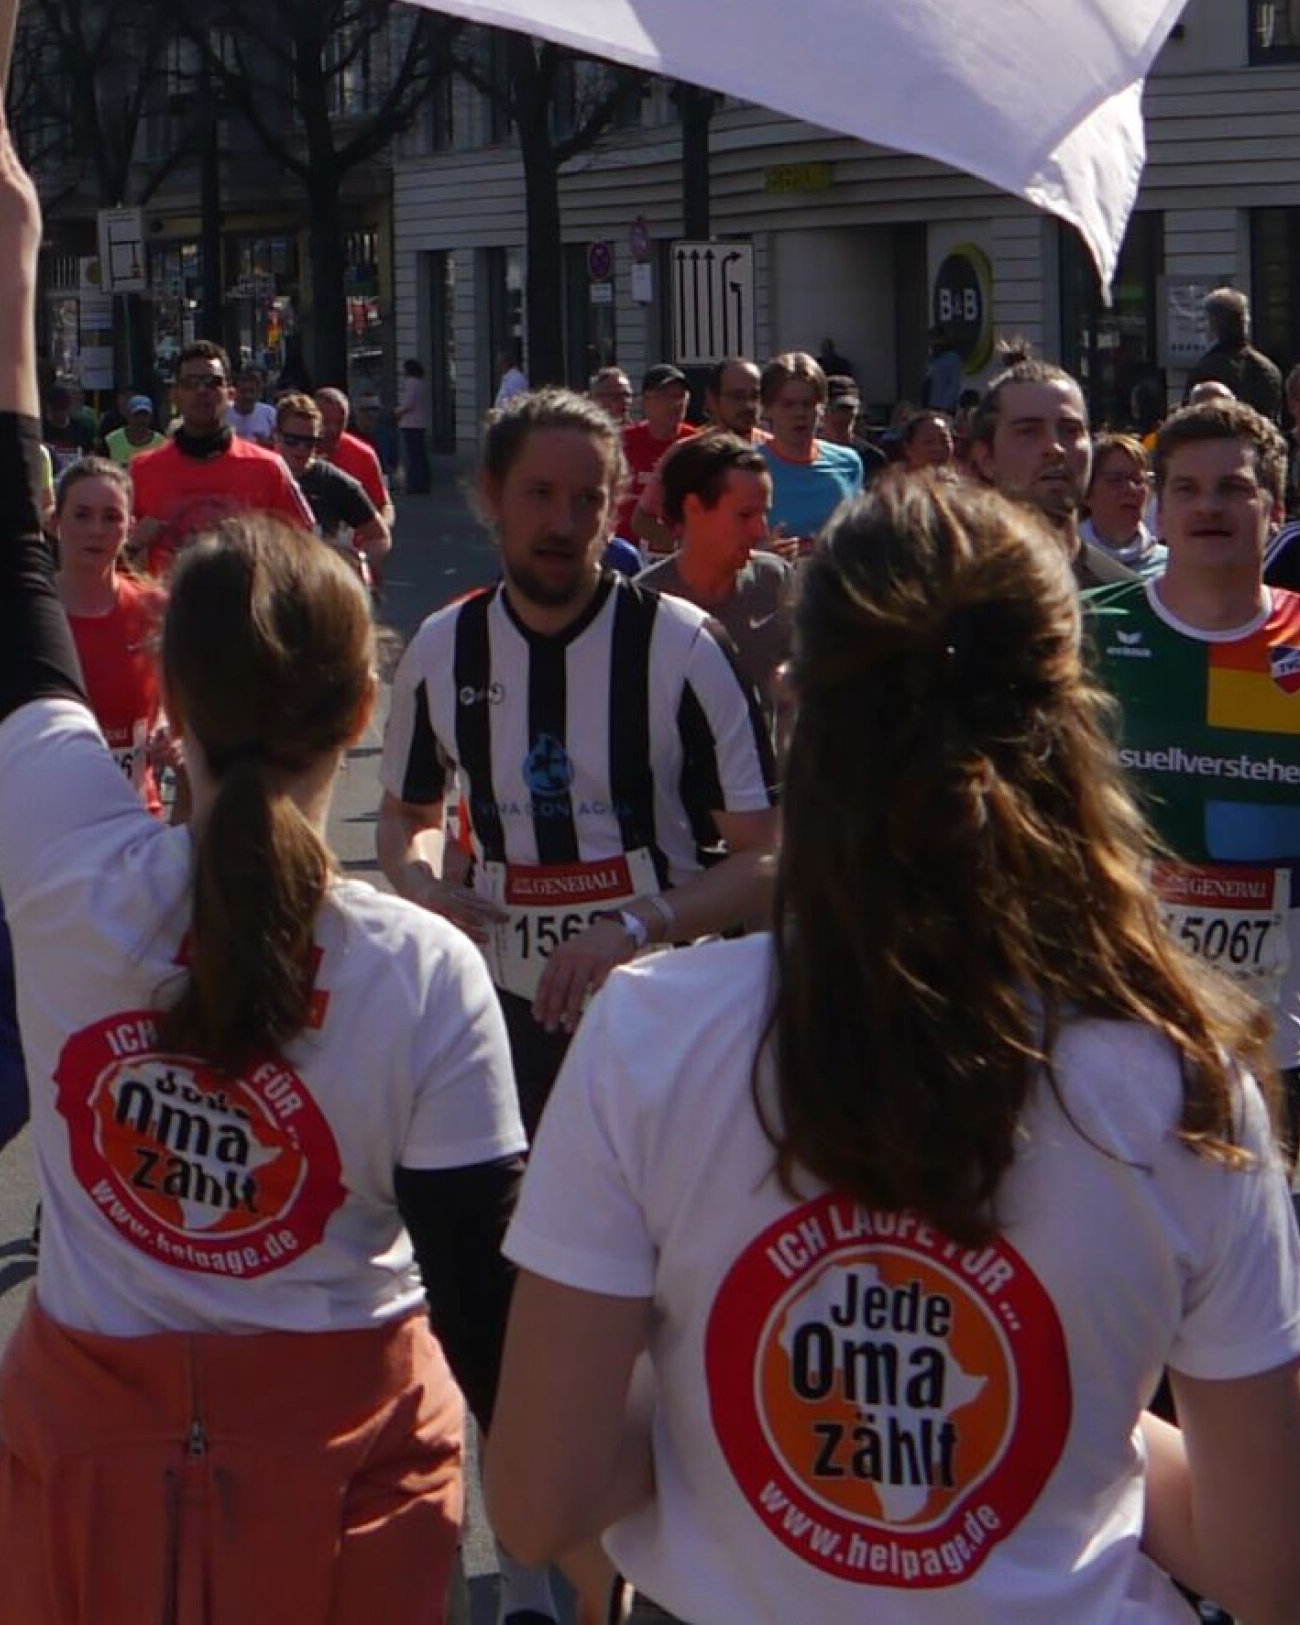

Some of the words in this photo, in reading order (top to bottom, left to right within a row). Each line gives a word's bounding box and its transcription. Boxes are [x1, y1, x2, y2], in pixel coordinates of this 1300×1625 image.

[532, 869, 620, 896] GENERALI
[515, 910, 602, 959] 156
[1162, 913, 1272, 965] 5067
[766, 1217, 827, 1278] ICH
[830, 1273, 951, 1337] Jede
[792, 1321, 946, 1410] Oma
